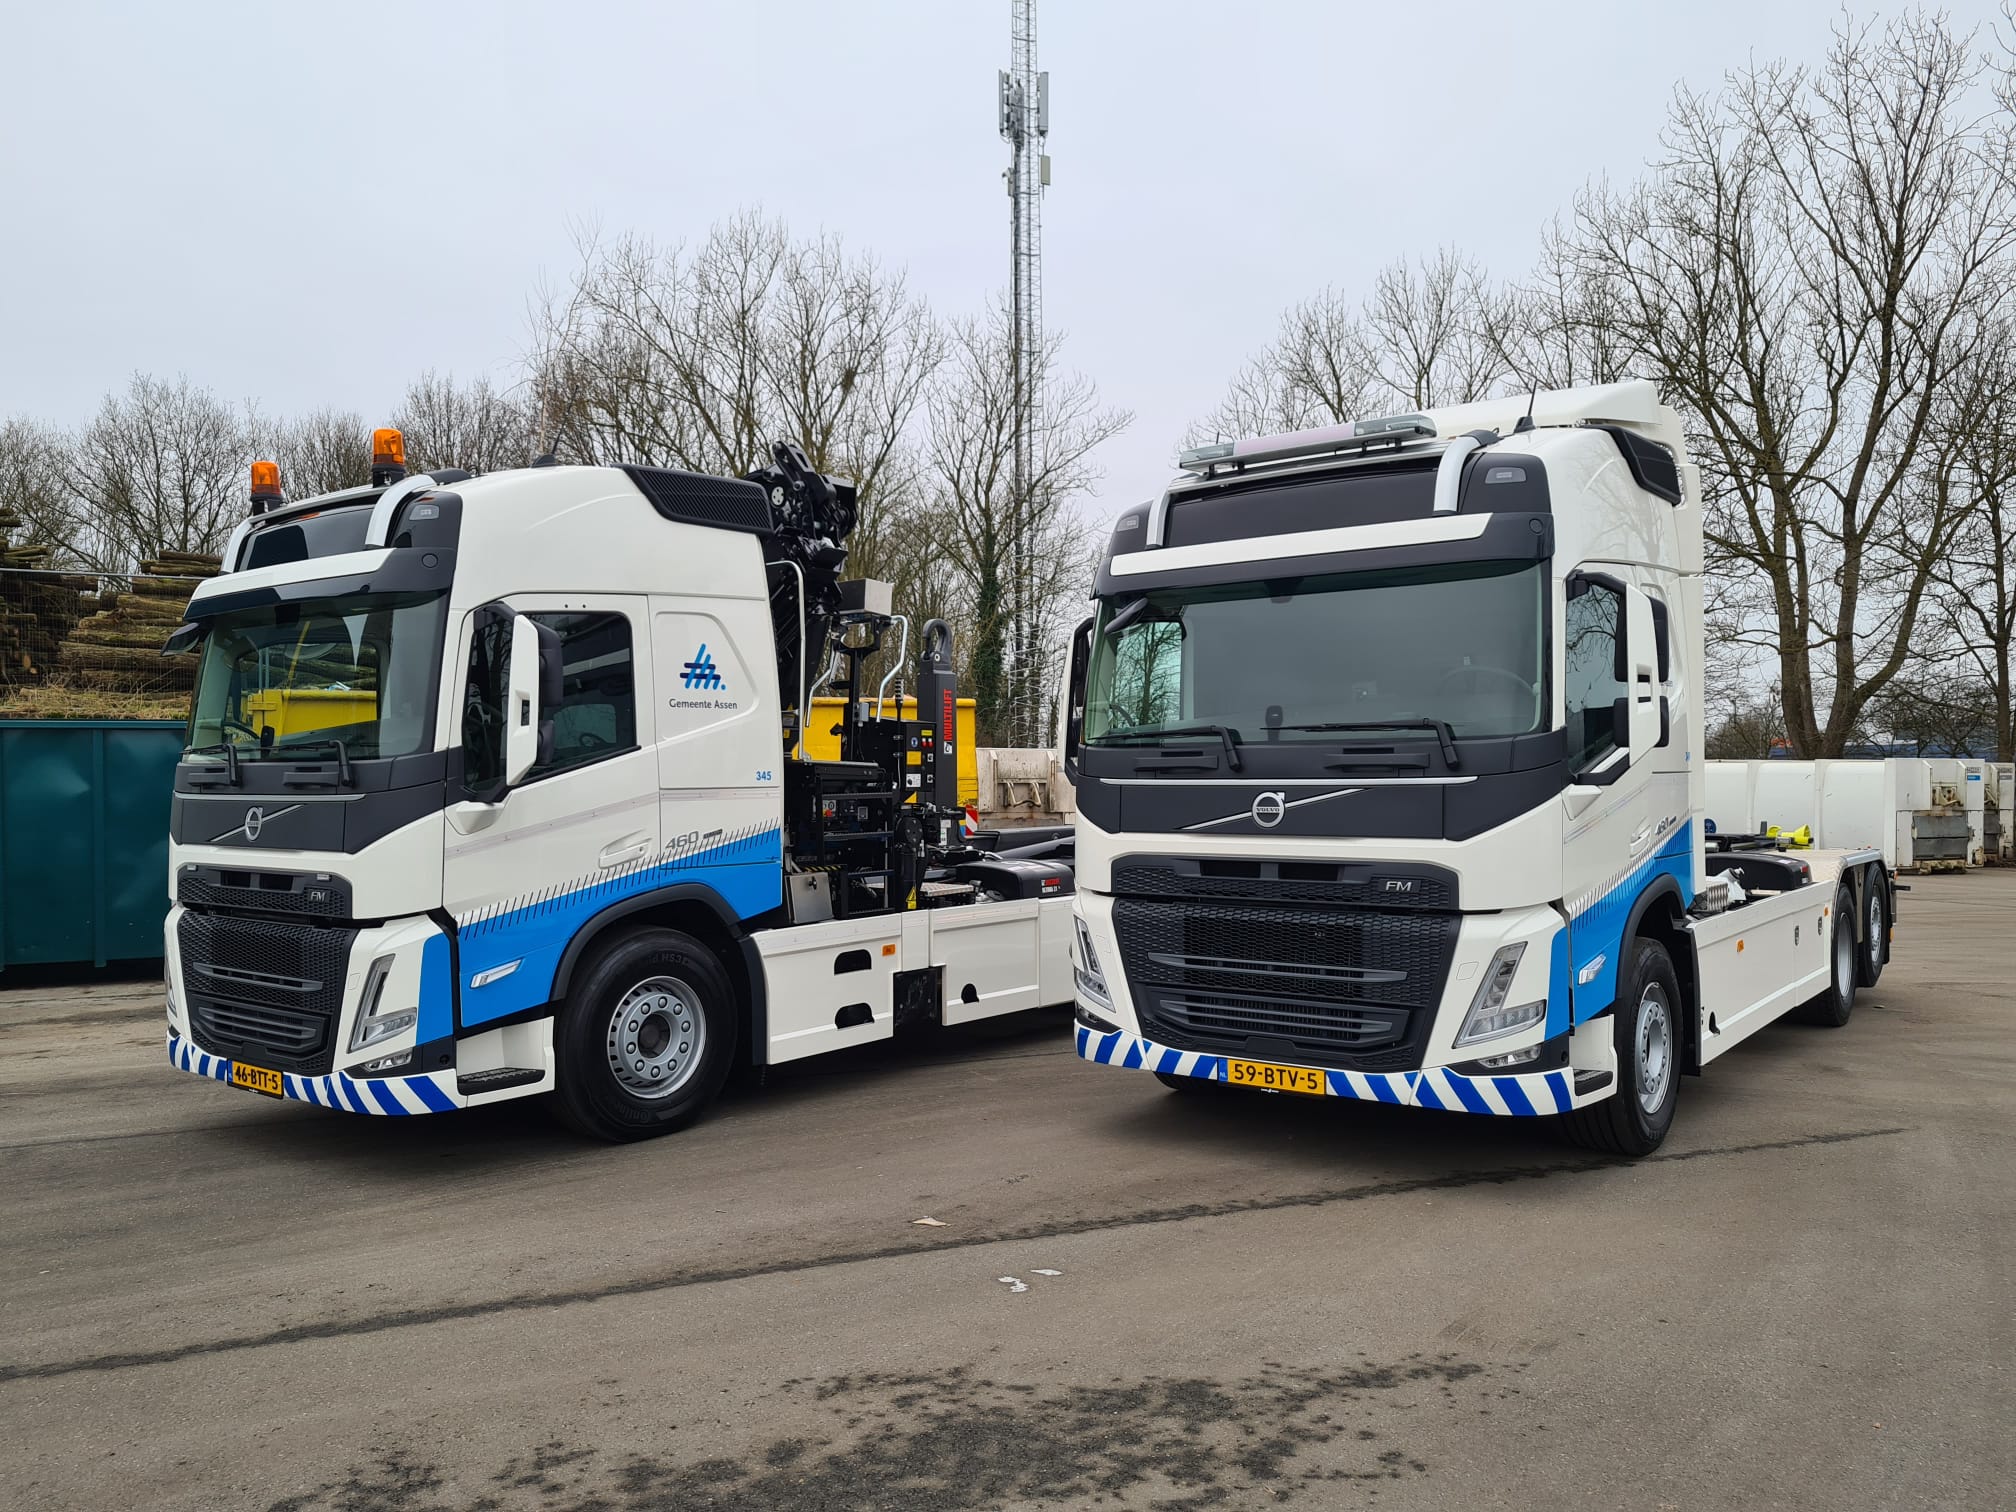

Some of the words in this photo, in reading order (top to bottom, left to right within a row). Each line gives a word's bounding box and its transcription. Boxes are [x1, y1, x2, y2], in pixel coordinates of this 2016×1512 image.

[669, 698, 712, 709] Gemeente
[714, 700, 737, 709] Assen
[944, 689, 952, 741] MULTILIFT
[756, 770, 772, 781] 345
[664, 831, 699, 849] 460
[1385, 881, 1412, 891] FM
[311, 891, 325, 901] FM
[235, 1065, 279, 1090] 46-BTT-5
[1234, 1064, 1318, 1090] 59-BTV-5
